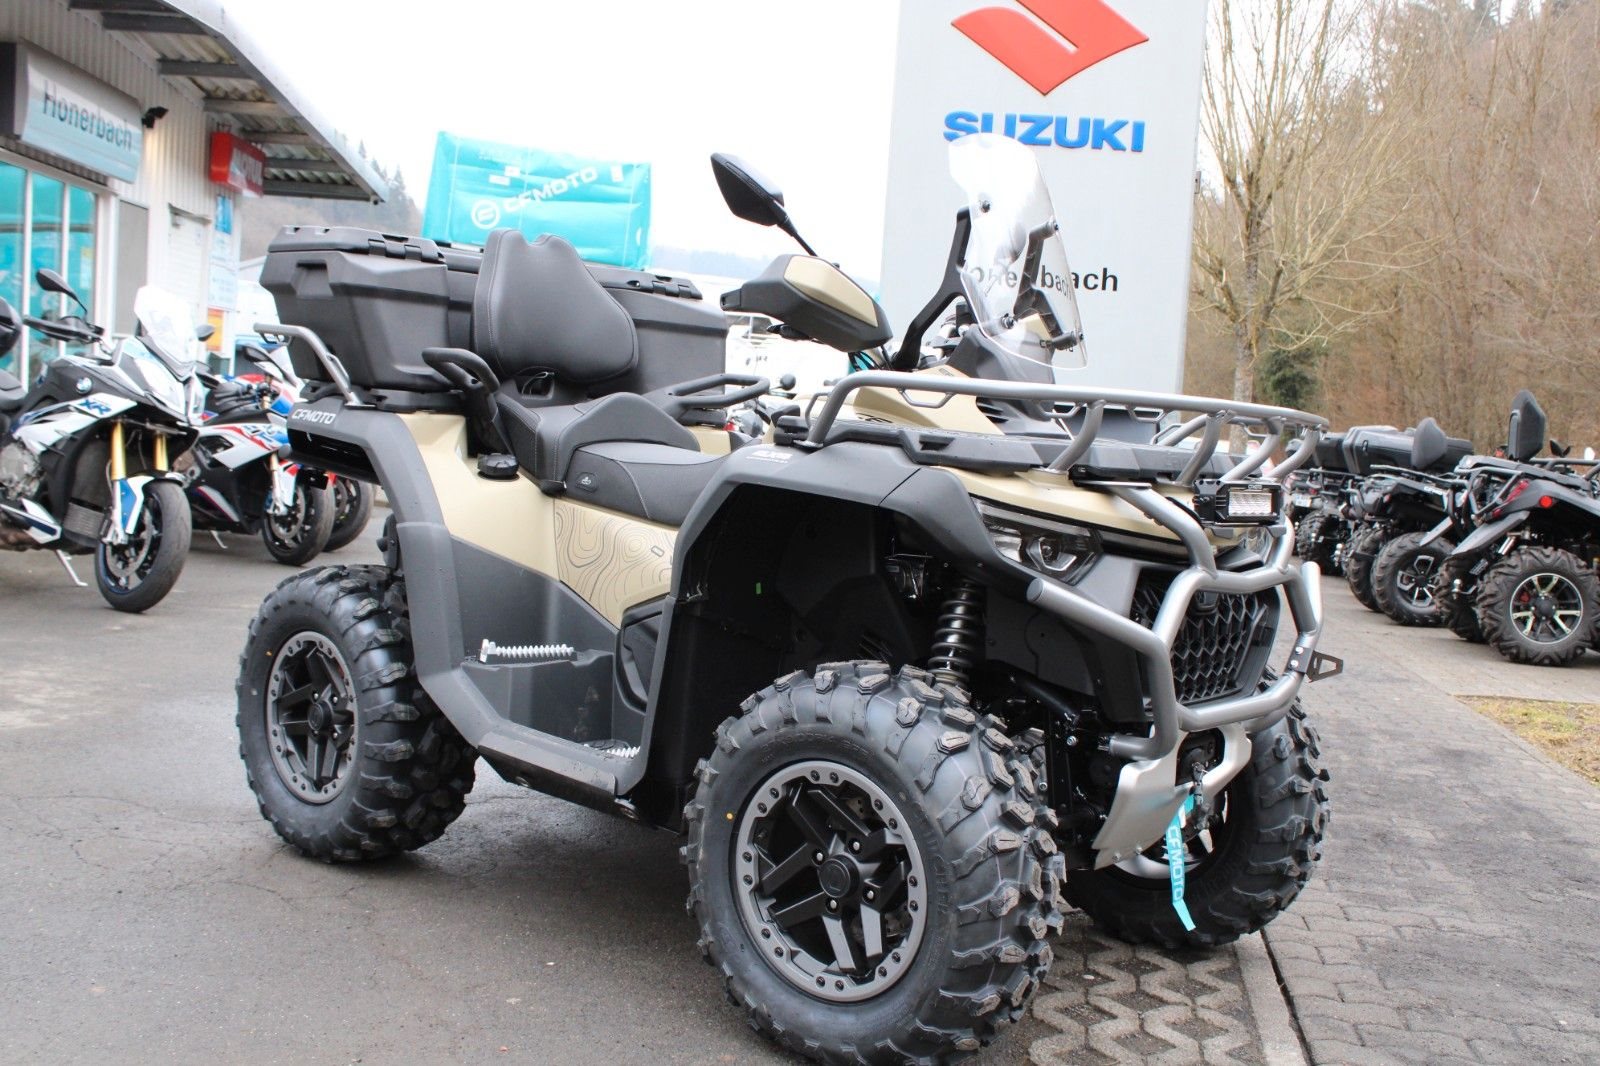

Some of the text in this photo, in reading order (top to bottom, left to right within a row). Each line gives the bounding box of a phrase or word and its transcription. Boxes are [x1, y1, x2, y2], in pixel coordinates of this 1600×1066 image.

[942, 110, 1146, 153] SUZUKI
[502, 166, 599, 212] CFMOTO
[291, 407, 337, 425] CFMOTO
[1168, 827, 1184, 902] CFMOTO
